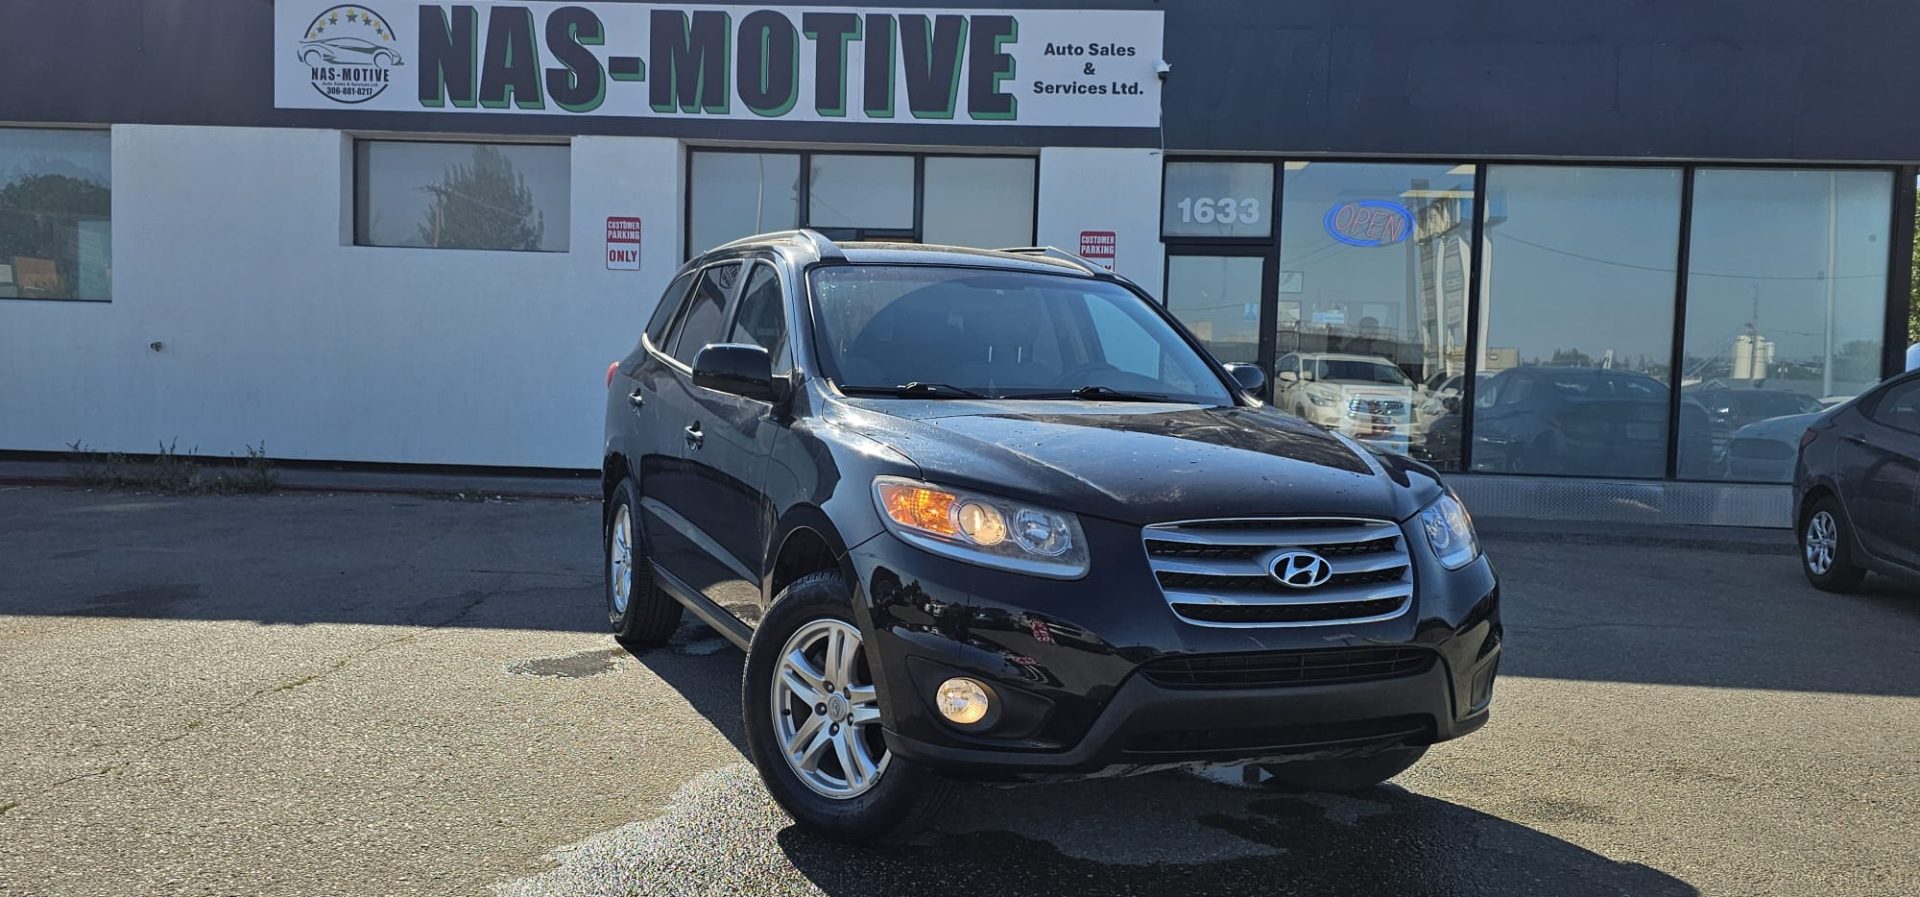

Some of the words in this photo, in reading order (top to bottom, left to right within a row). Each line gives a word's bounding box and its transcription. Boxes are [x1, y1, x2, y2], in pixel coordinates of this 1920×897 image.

[1044, 42, 1084, 56] Auto
[1088, 43, 1136, 57] Sales
[418, 5, 1018, 121] NAS-MOTIVE
[1083, 62, 1096, 75] &
[311, 67, 390, 82] NAS-MOTIVE
[1033, 81, 1107, 95] Services
[1112, 81, 1144, 95] Ltd.
[1177, 198, 1260, 224] 1633
[608, 221, 640, 229] CUSTOMER
[1335, 204, 1404, 242] OPEN
[608, 230, 640, 239] PARKING
[1081, 235, 1114, 244] CUSTOMER
[609, 249, 637, 262] ONLY
[1081, 245, 1114, 254] PARKING
